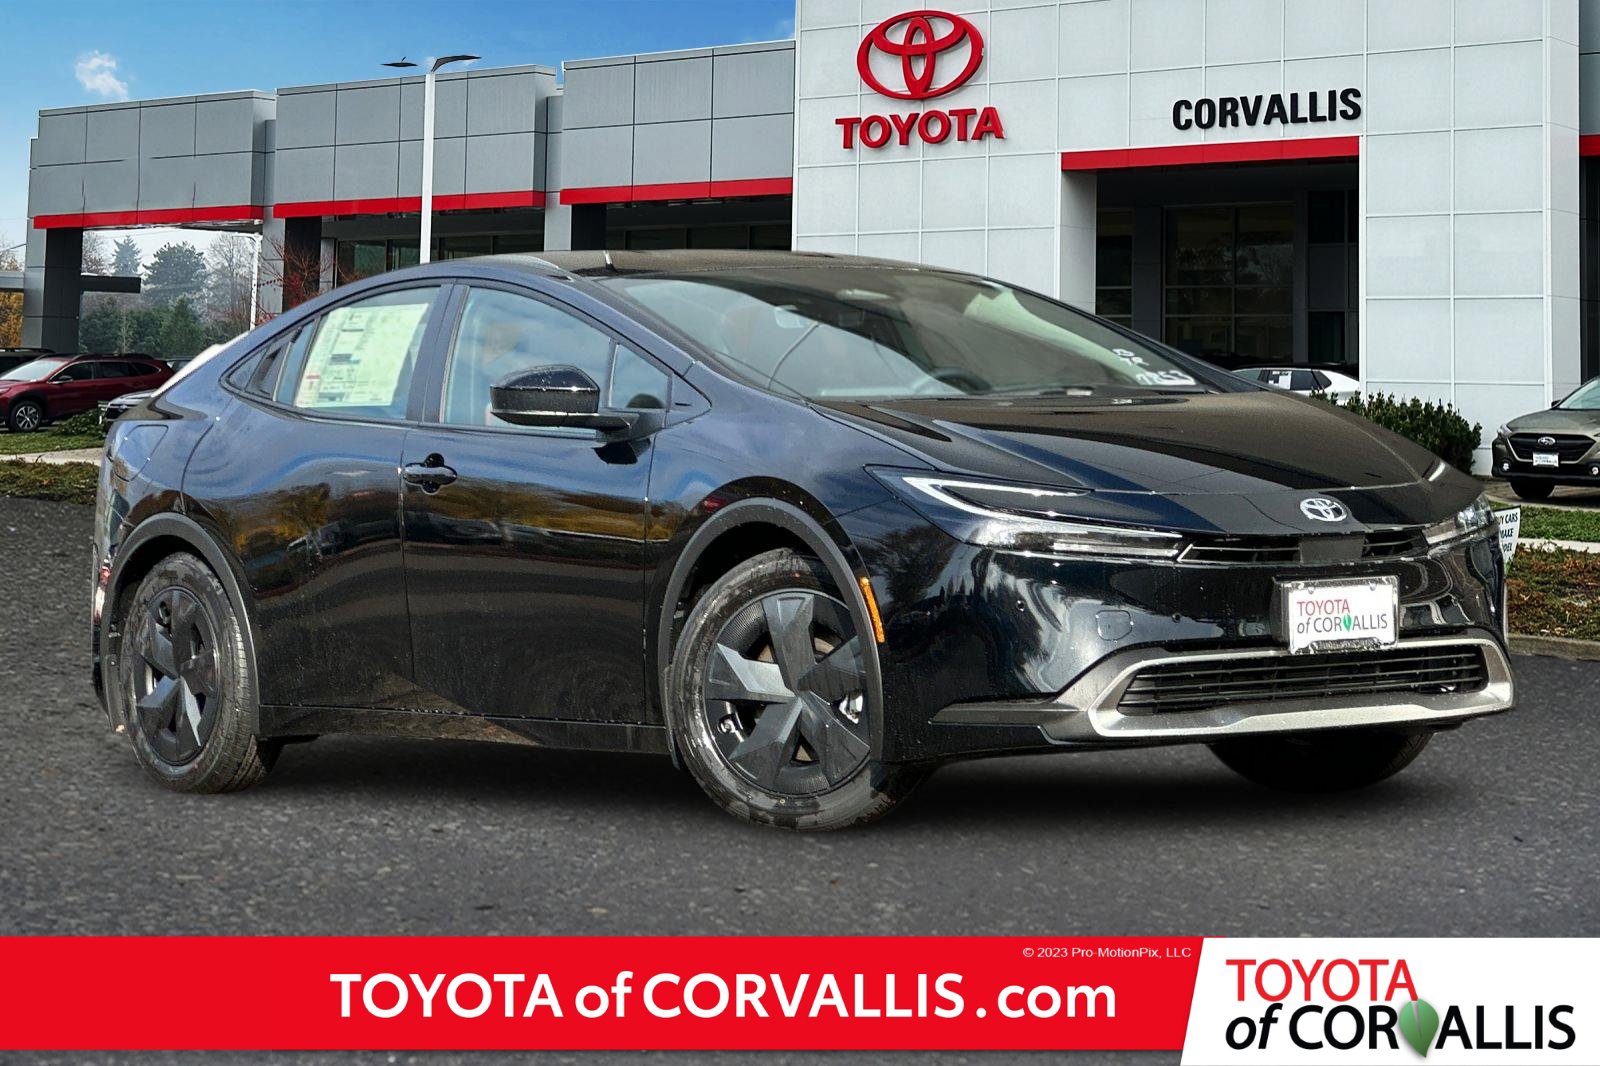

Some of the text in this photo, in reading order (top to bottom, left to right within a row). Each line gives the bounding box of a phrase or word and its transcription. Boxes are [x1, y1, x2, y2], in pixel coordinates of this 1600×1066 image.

[1172, 88, 1362, 131] CORVALLIS
[835, 106, 1005, 150] TOYOTA
[1296, 599, 1351, 617] TOYOTA
[1297, 617, 1311, 634] of
